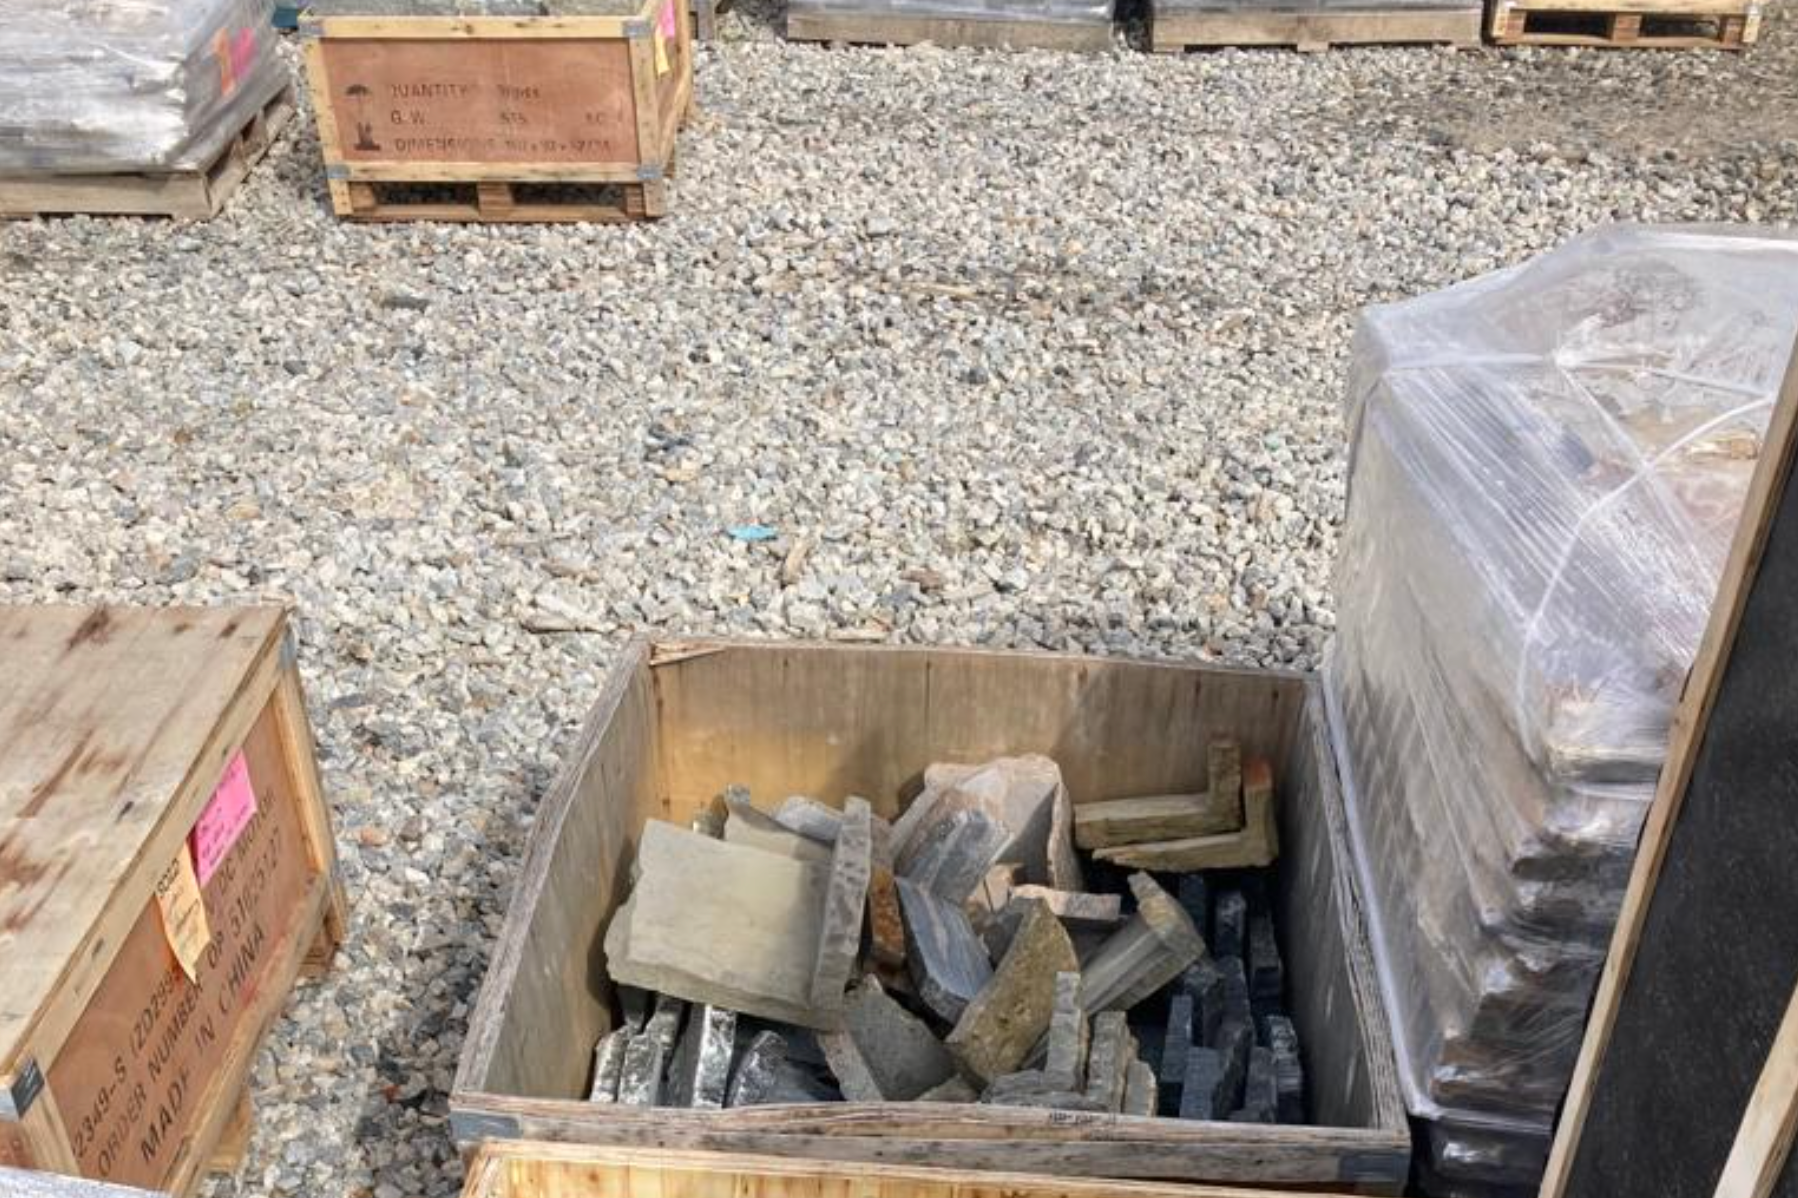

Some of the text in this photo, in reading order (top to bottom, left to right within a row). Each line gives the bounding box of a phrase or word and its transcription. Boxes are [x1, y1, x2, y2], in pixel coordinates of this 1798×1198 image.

[194, 1014, 216, 1052] IN
[218, 922, 264, 1015] CHINA
[97, 1083, 147, 1178] ORDER
